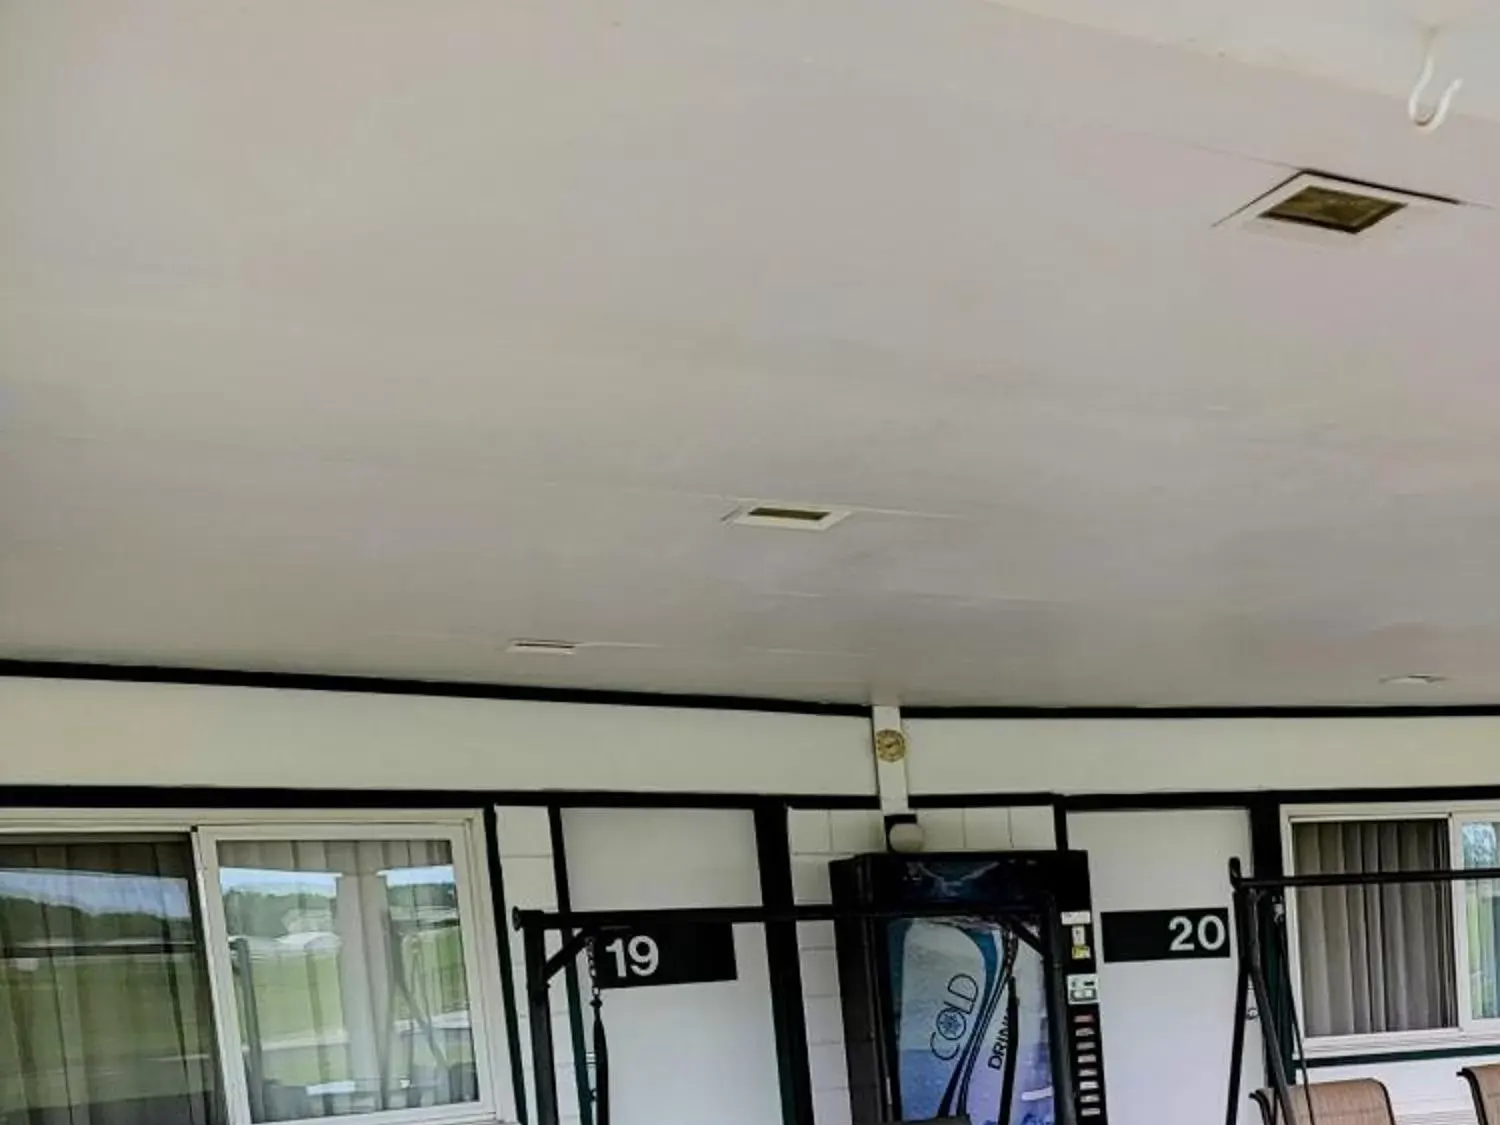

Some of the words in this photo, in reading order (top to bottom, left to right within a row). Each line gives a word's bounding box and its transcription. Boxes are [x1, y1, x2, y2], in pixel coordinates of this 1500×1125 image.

[605, 935, 659, 978] 19
[1168, 915, 1226, 951] 20
[930, 973, 979, 1061] COLD
[987, 1008, 1009, 1071] DRIN
